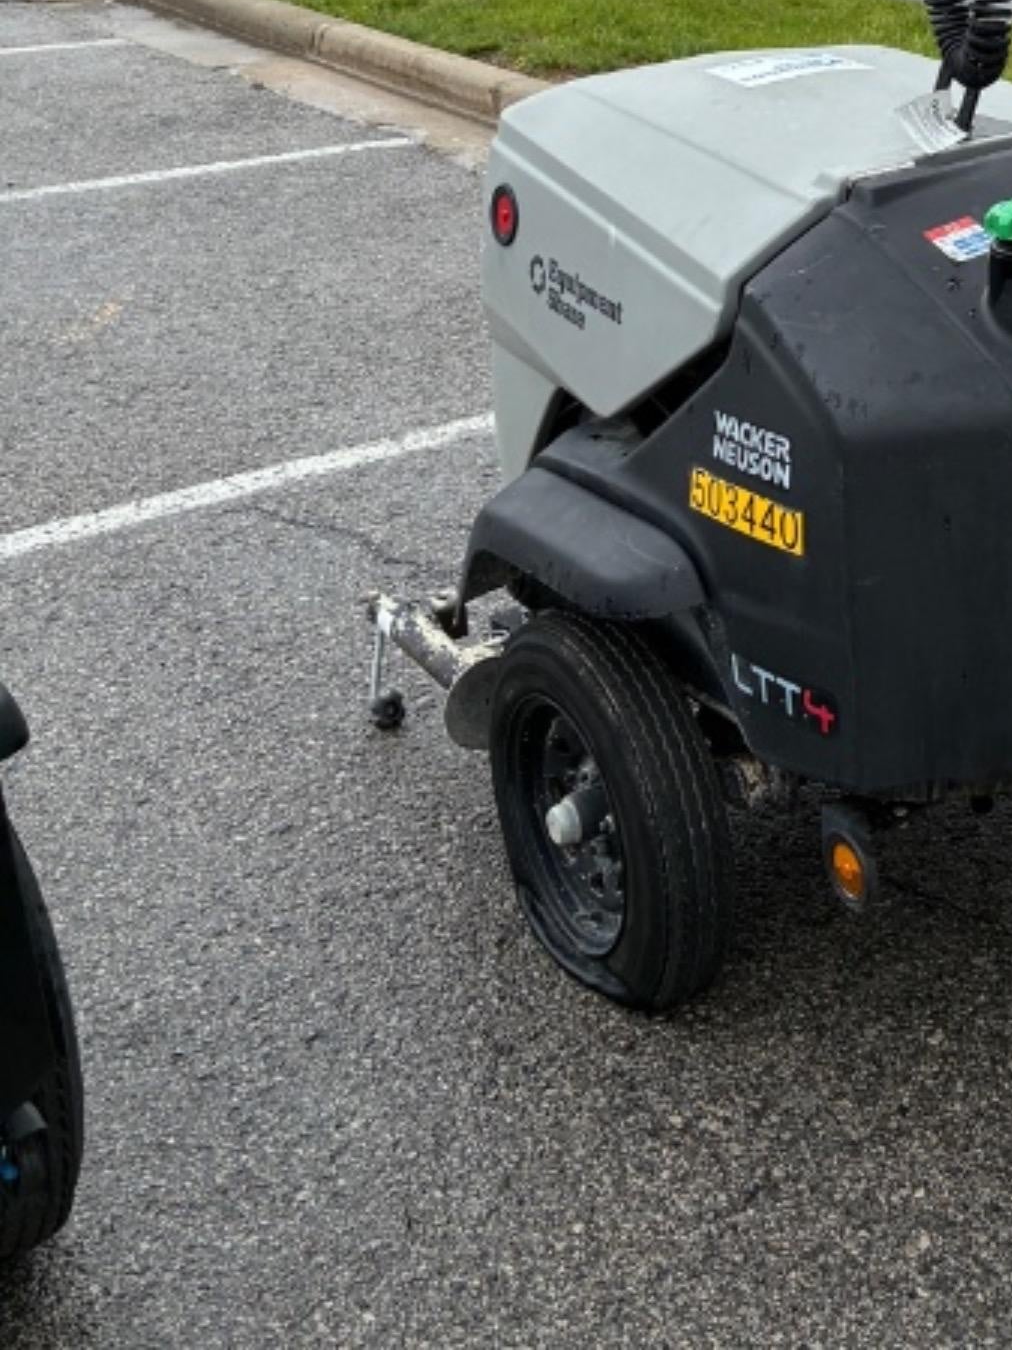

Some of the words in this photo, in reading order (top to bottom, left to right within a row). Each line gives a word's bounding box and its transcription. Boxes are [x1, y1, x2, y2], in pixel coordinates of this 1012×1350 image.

[713, 410, 791, 463] WACKER
[713, 434, 791, 490] NEUSON
[692, 469, 800, 550] 503440
[731, 653, 834, 734] LTT4
